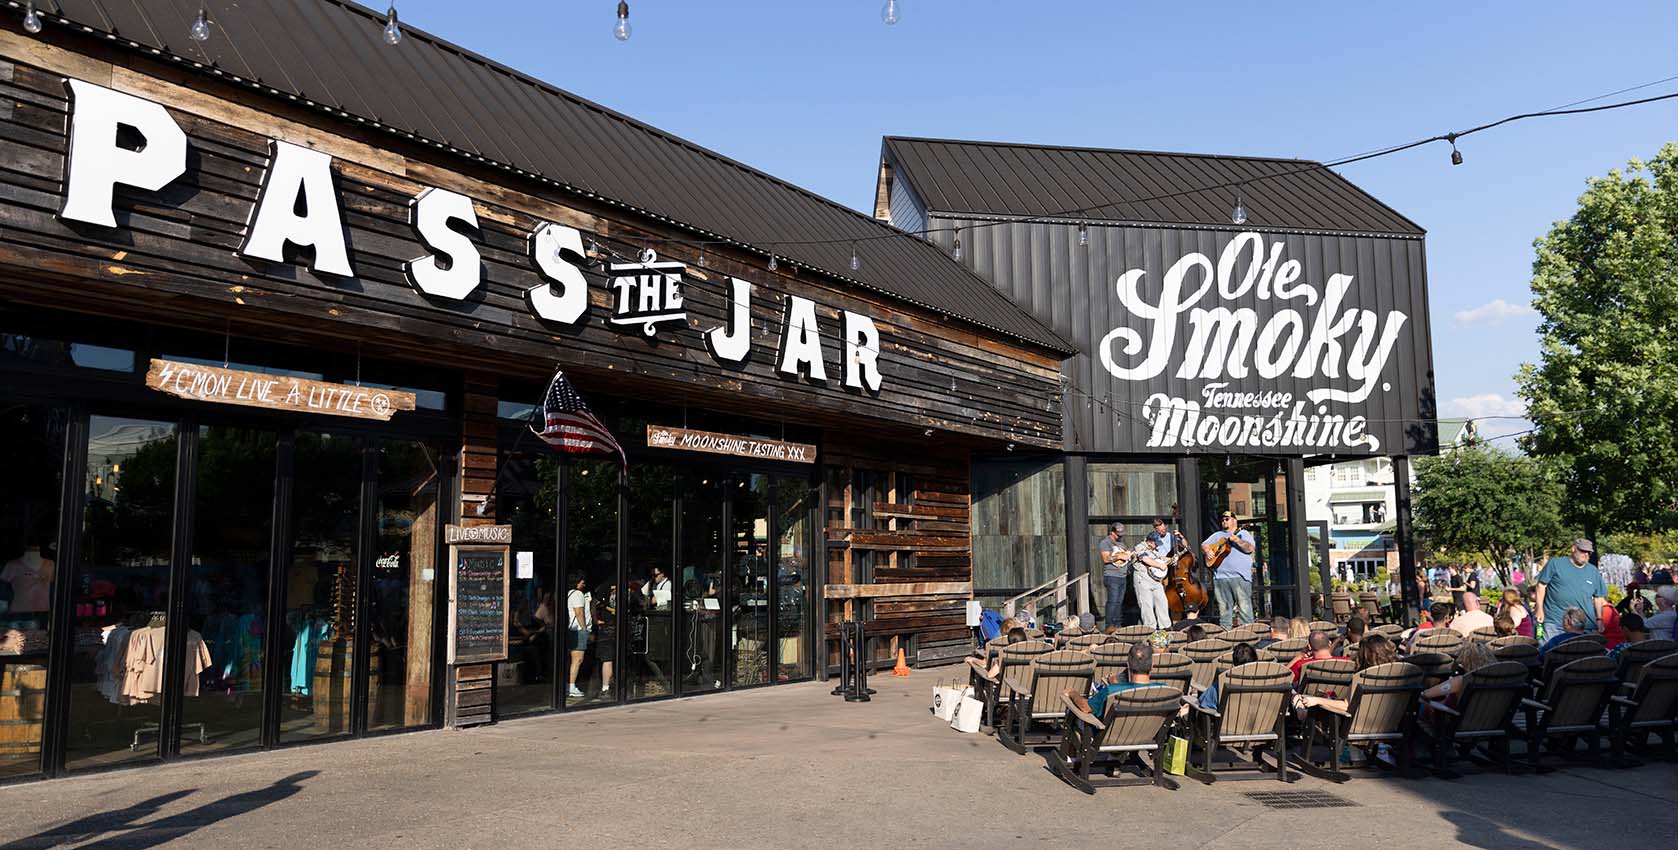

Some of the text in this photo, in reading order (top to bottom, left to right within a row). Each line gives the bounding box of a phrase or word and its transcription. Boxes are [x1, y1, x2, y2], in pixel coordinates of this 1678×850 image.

[53, 77, 883, 393] PASS THE JAR
[1217, 231, 1318, 306] Ole
[236, 377, 279, 403] LIVE
[285, 382, 300, 405] A
[308, 387, 368, 414] LITTLE
[1202, 382, 1293, 409] Tennessee
[1142, 392, 1381, 452] Moonshine
[680, 434, 747, 453] MOONSHINE
[748, 441, 785, 458] TASTING
[787, 446, 805, 461] XXX
[450, 527, 507, 541] LIVE MUSIC
